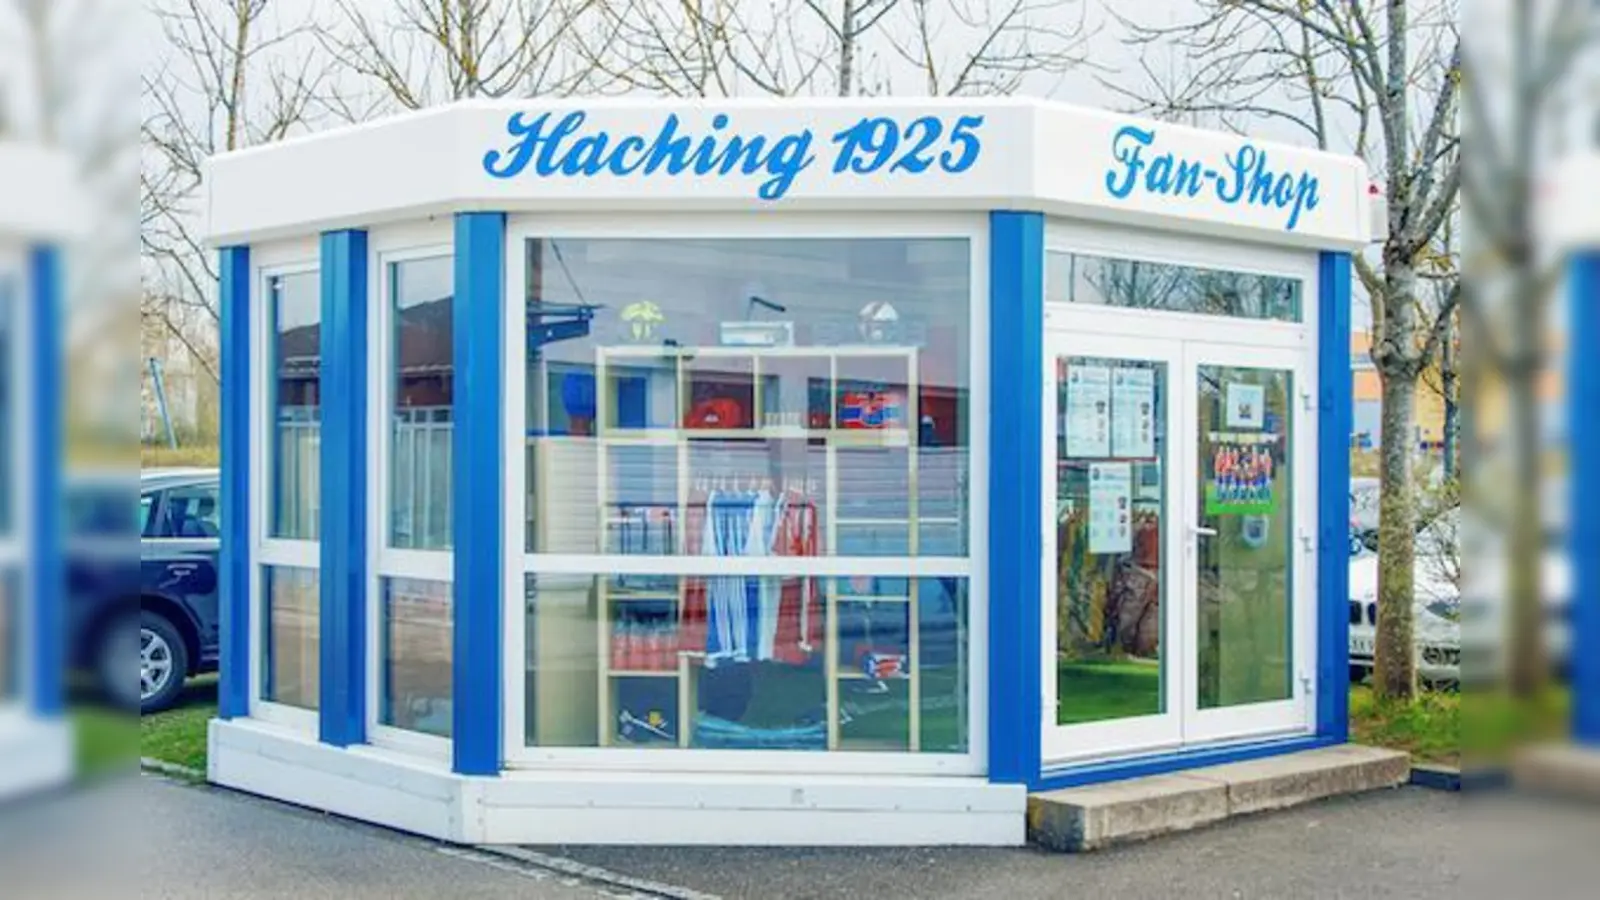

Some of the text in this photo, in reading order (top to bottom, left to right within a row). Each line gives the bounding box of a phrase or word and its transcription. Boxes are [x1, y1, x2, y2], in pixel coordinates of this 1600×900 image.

[482, 111, 985, 200] Haching 1925
[1105, 125, 1320, 230] Fan-Shop
